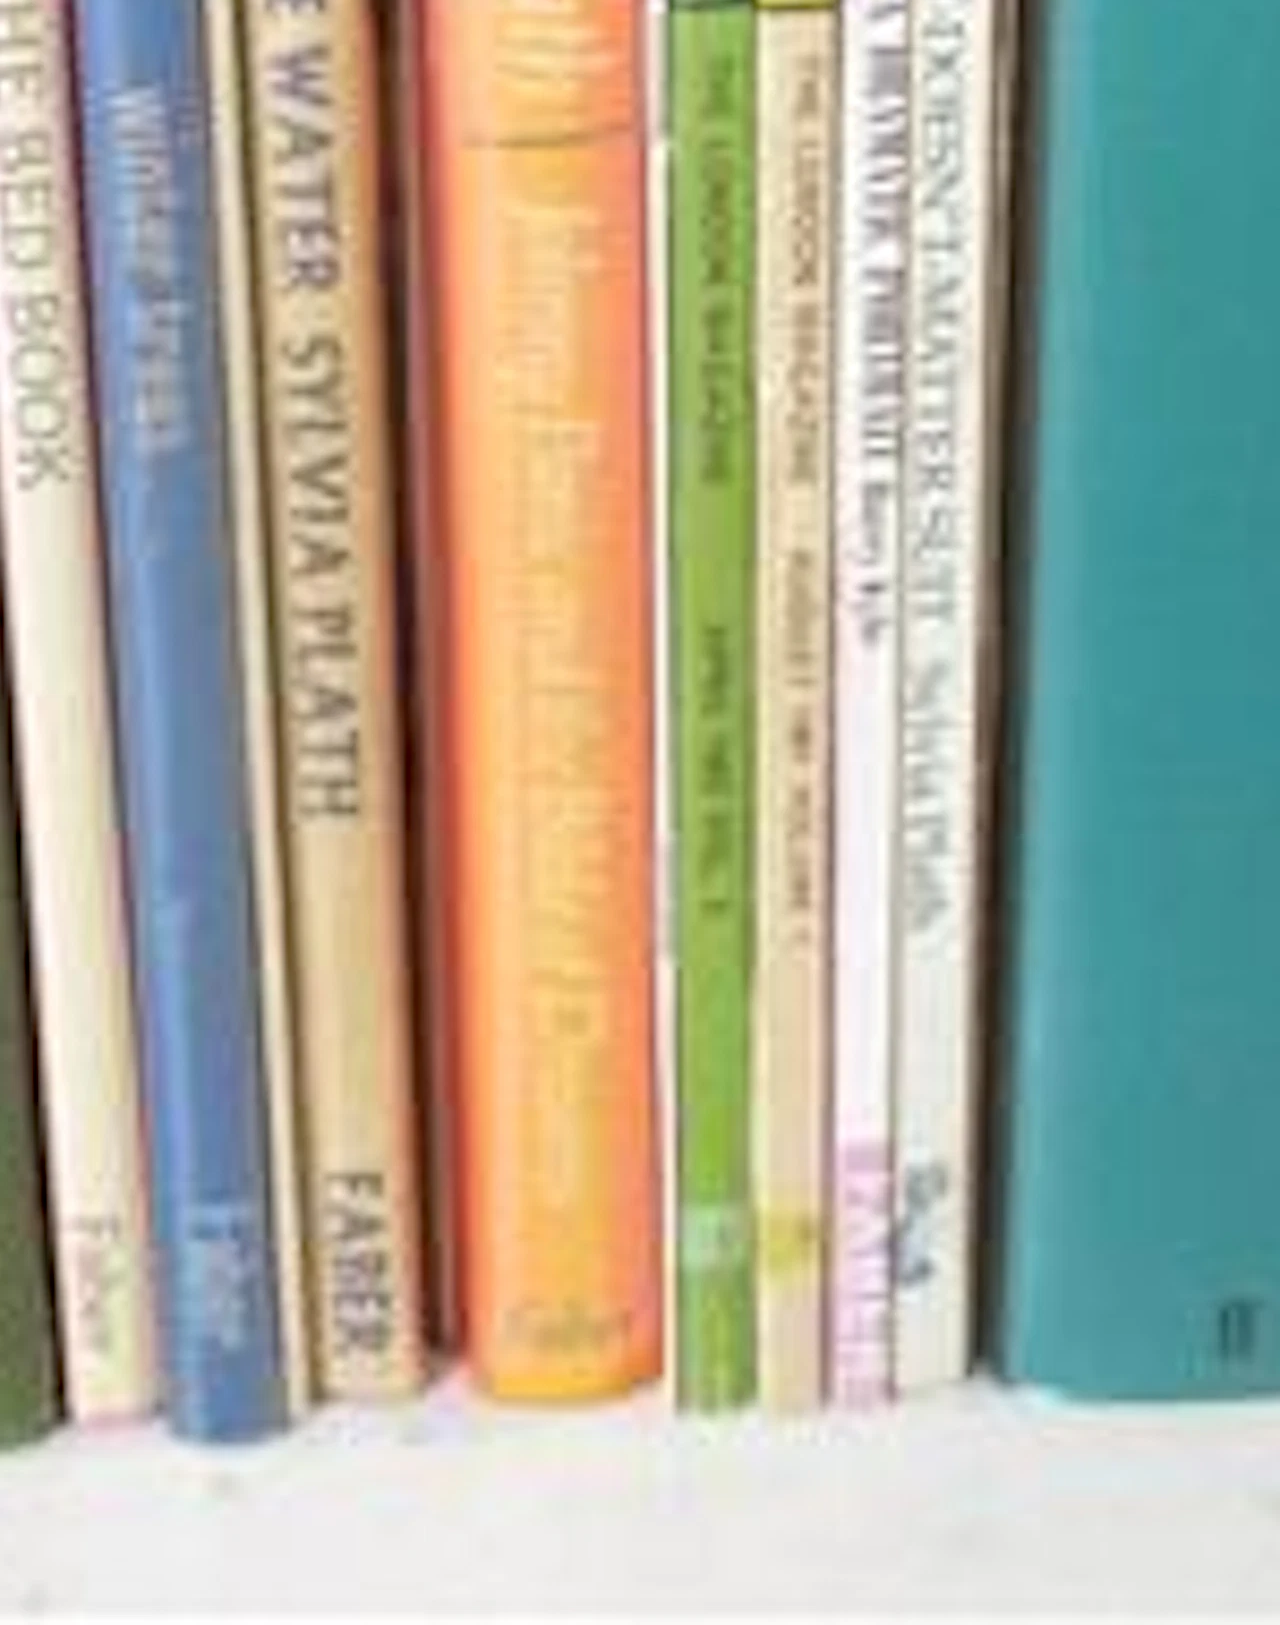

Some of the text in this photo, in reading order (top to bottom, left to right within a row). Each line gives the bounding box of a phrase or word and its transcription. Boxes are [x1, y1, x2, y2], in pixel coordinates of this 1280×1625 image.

[270, 39, 350, 292] WATER
[12, 286, 88, 492] BOOK
[280, 324, 365, 582] SYLVIA
[298, 594, 372, 826] PLATH
